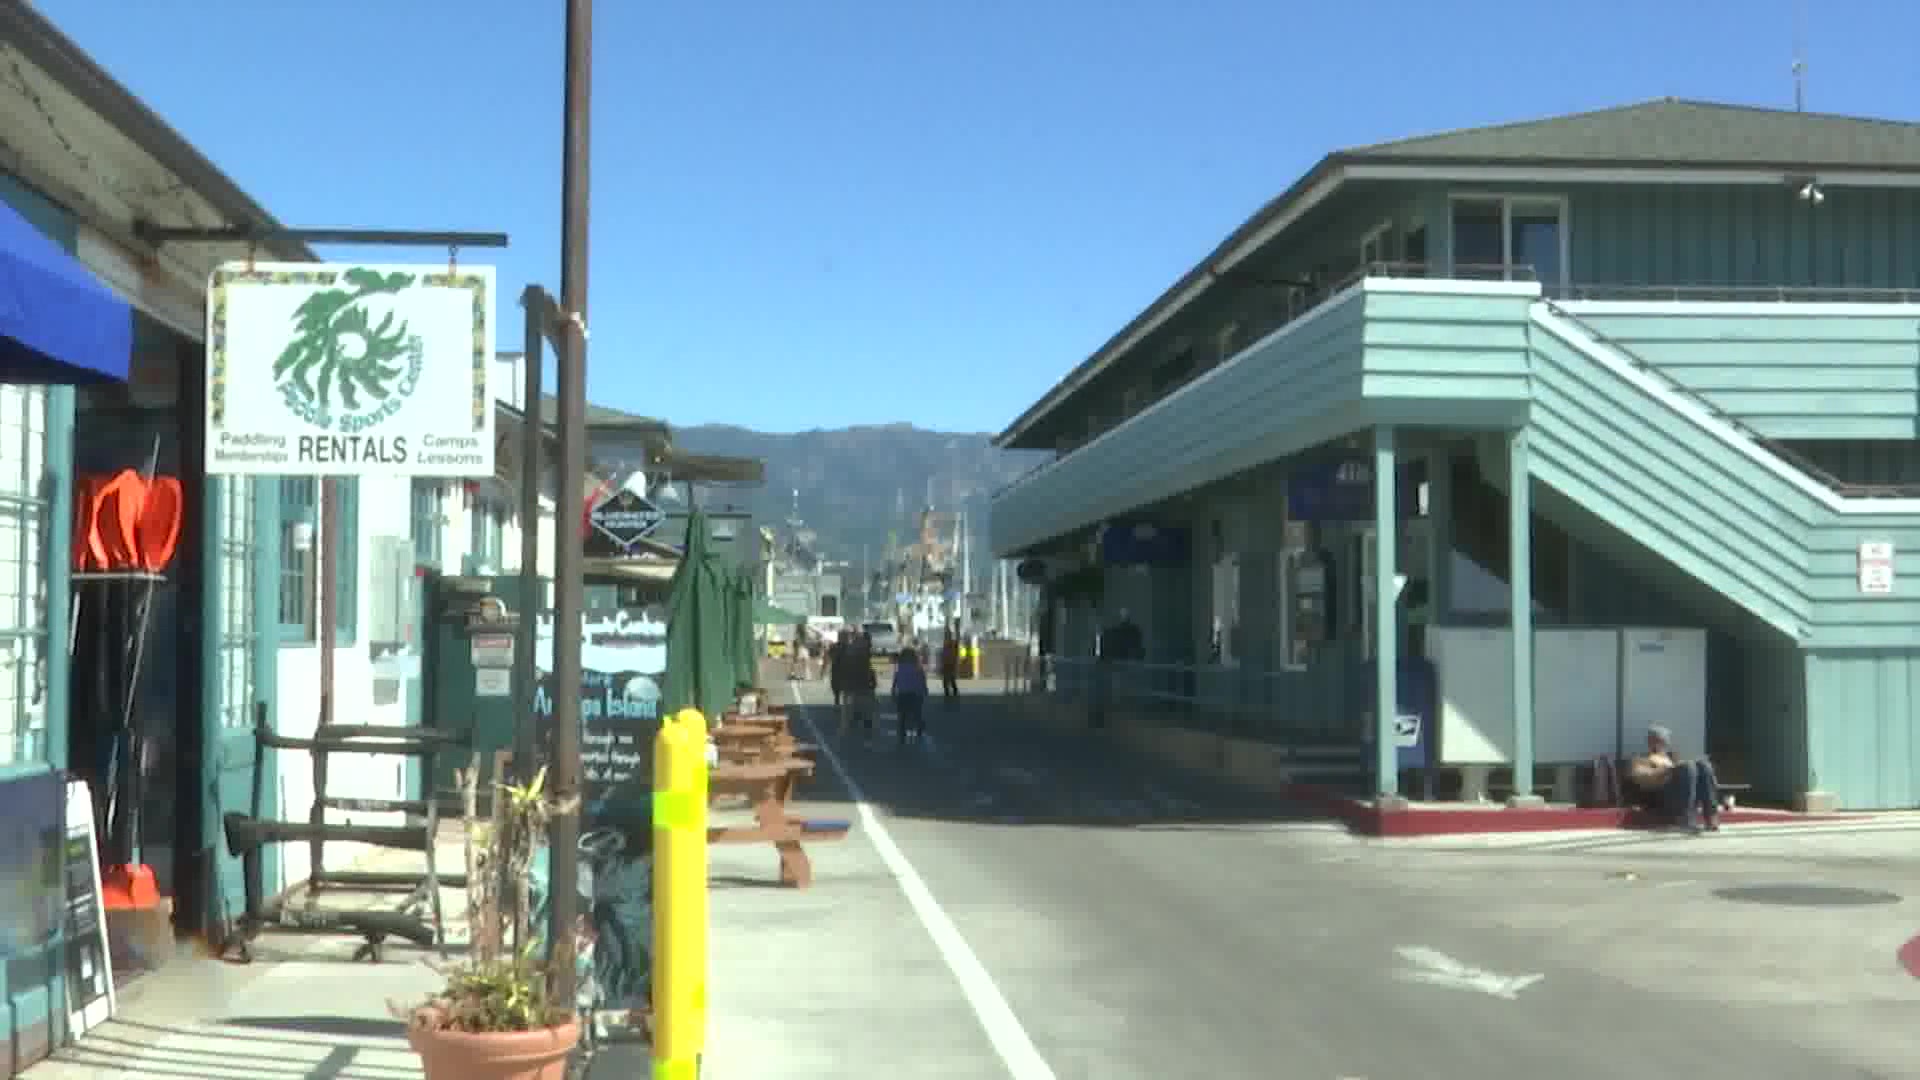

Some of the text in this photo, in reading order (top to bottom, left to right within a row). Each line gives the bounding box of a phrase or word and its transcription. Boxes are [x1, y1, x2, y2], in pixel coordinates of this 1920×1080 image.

[338, 398, 403, 433] Sports
[219, 432, 287, 449] Paddling
[422, 433, 479, 450] Camps
[298, 435, 408, 464] RENTALS
[416, 450, 483, 465] Lessons
